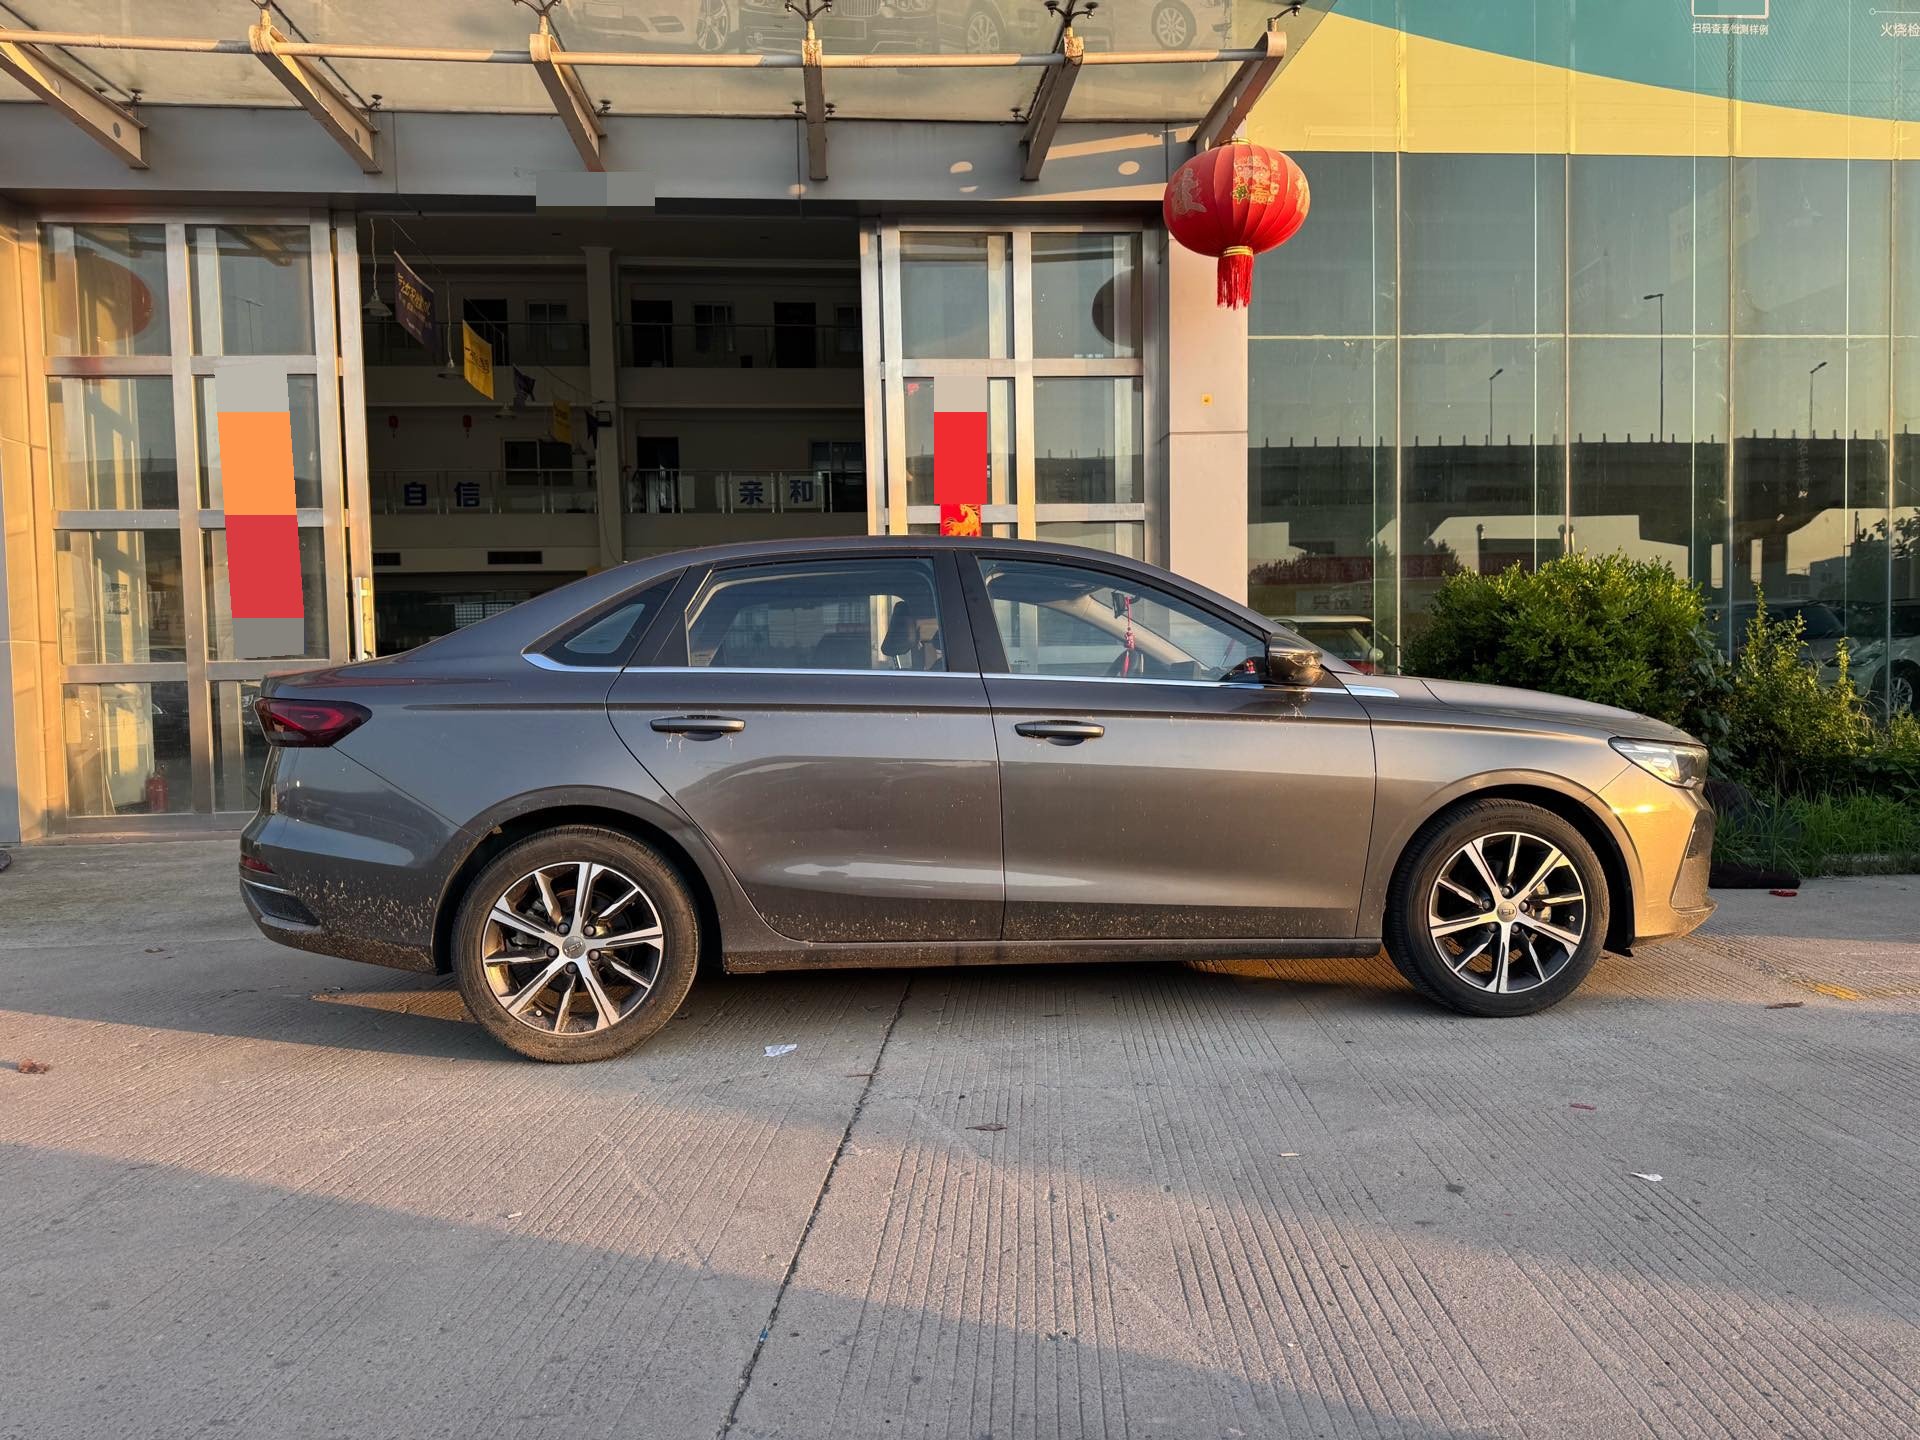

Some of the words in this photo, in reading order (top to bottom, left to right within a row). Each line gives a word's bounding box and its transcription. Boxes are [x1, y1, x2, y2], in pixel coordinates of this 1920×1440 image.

[1880, 22, 1920, 38] 火烧检
[404, 482, 481, 507] 自信
[738, 480, 814, 504] 亲和
